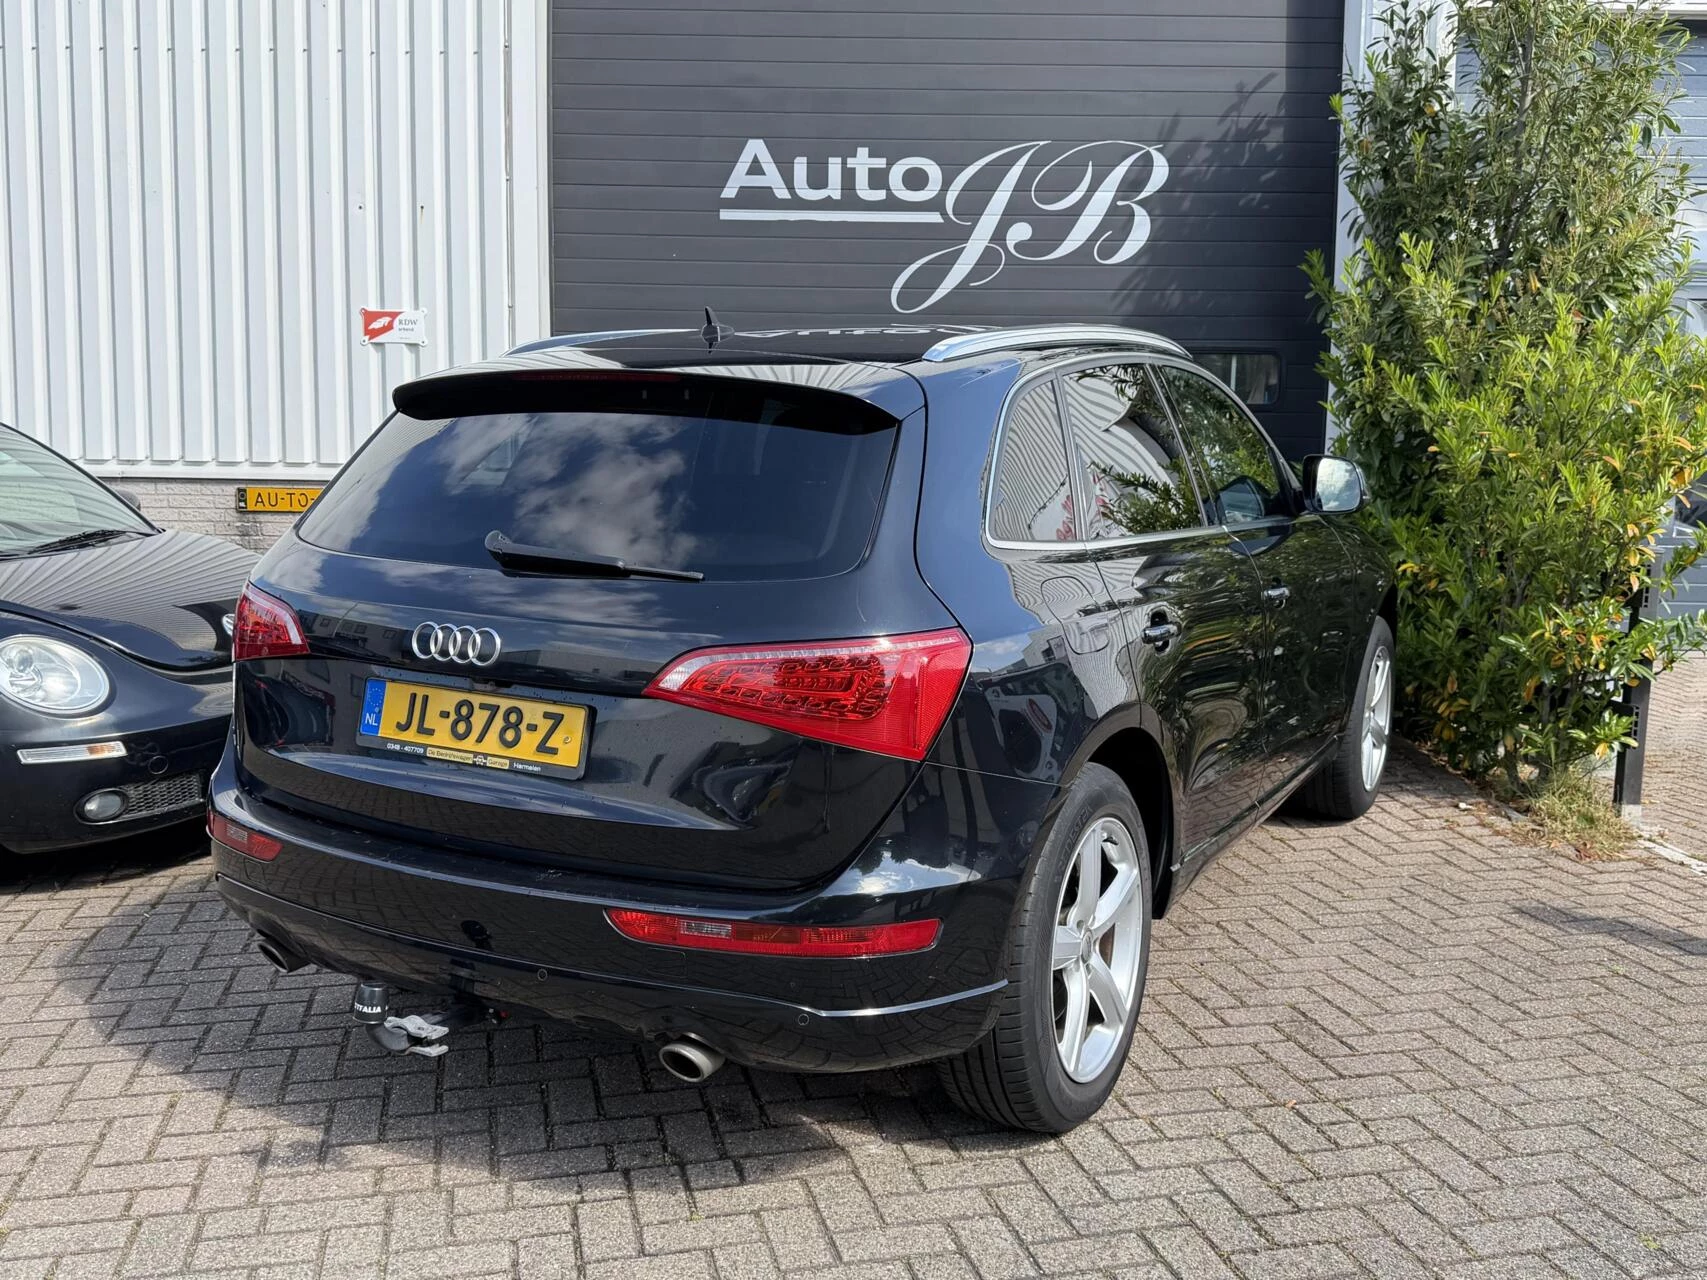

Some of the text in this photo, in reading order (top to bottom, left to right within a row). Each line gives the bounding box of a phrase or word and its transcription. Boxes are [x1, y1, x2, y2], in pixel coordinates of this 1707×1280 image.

[719, 138, 1170, 314] Auto JB
[398, 318, 418, 326] RDW
[365, 712, 378, 726] NL
[395, 692, 565, 756] JL-878-Z
[513, 762, 542, 772] Harmelen
